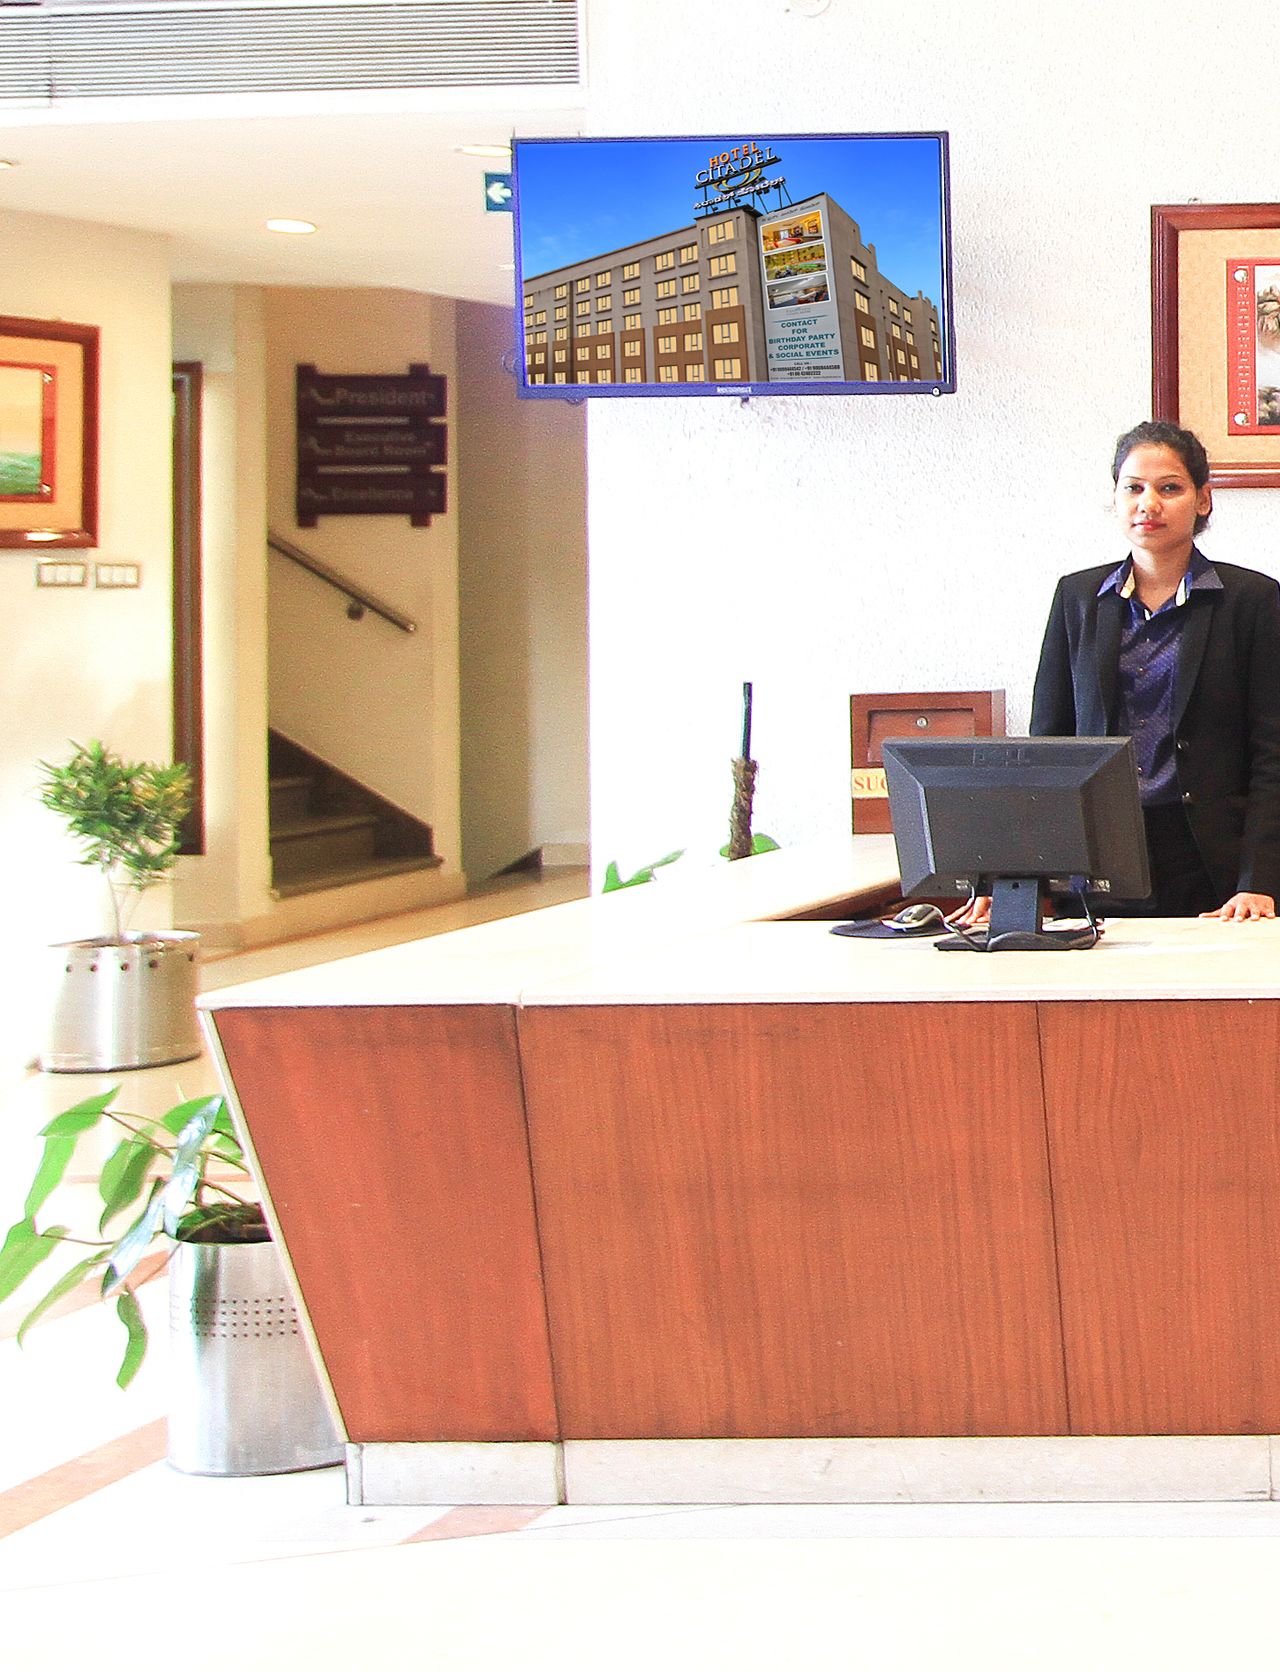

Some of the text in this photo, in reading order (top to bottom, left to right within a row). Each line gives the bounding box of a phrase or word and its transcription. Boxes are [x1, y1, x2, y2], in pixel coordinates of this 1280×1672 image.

[709, 142, 759, 168] HOTEL
[695, 147, 777, 183] CITADEL
[781, 319, 818, 328] CONTACT
[768, 333, 835, 344] BIRTHDAY PARTY
[778, 342, 826, 351] CORPORATE
[776, 351, 803, 359] SOCIAL
[335, 387, 428, 406] President
